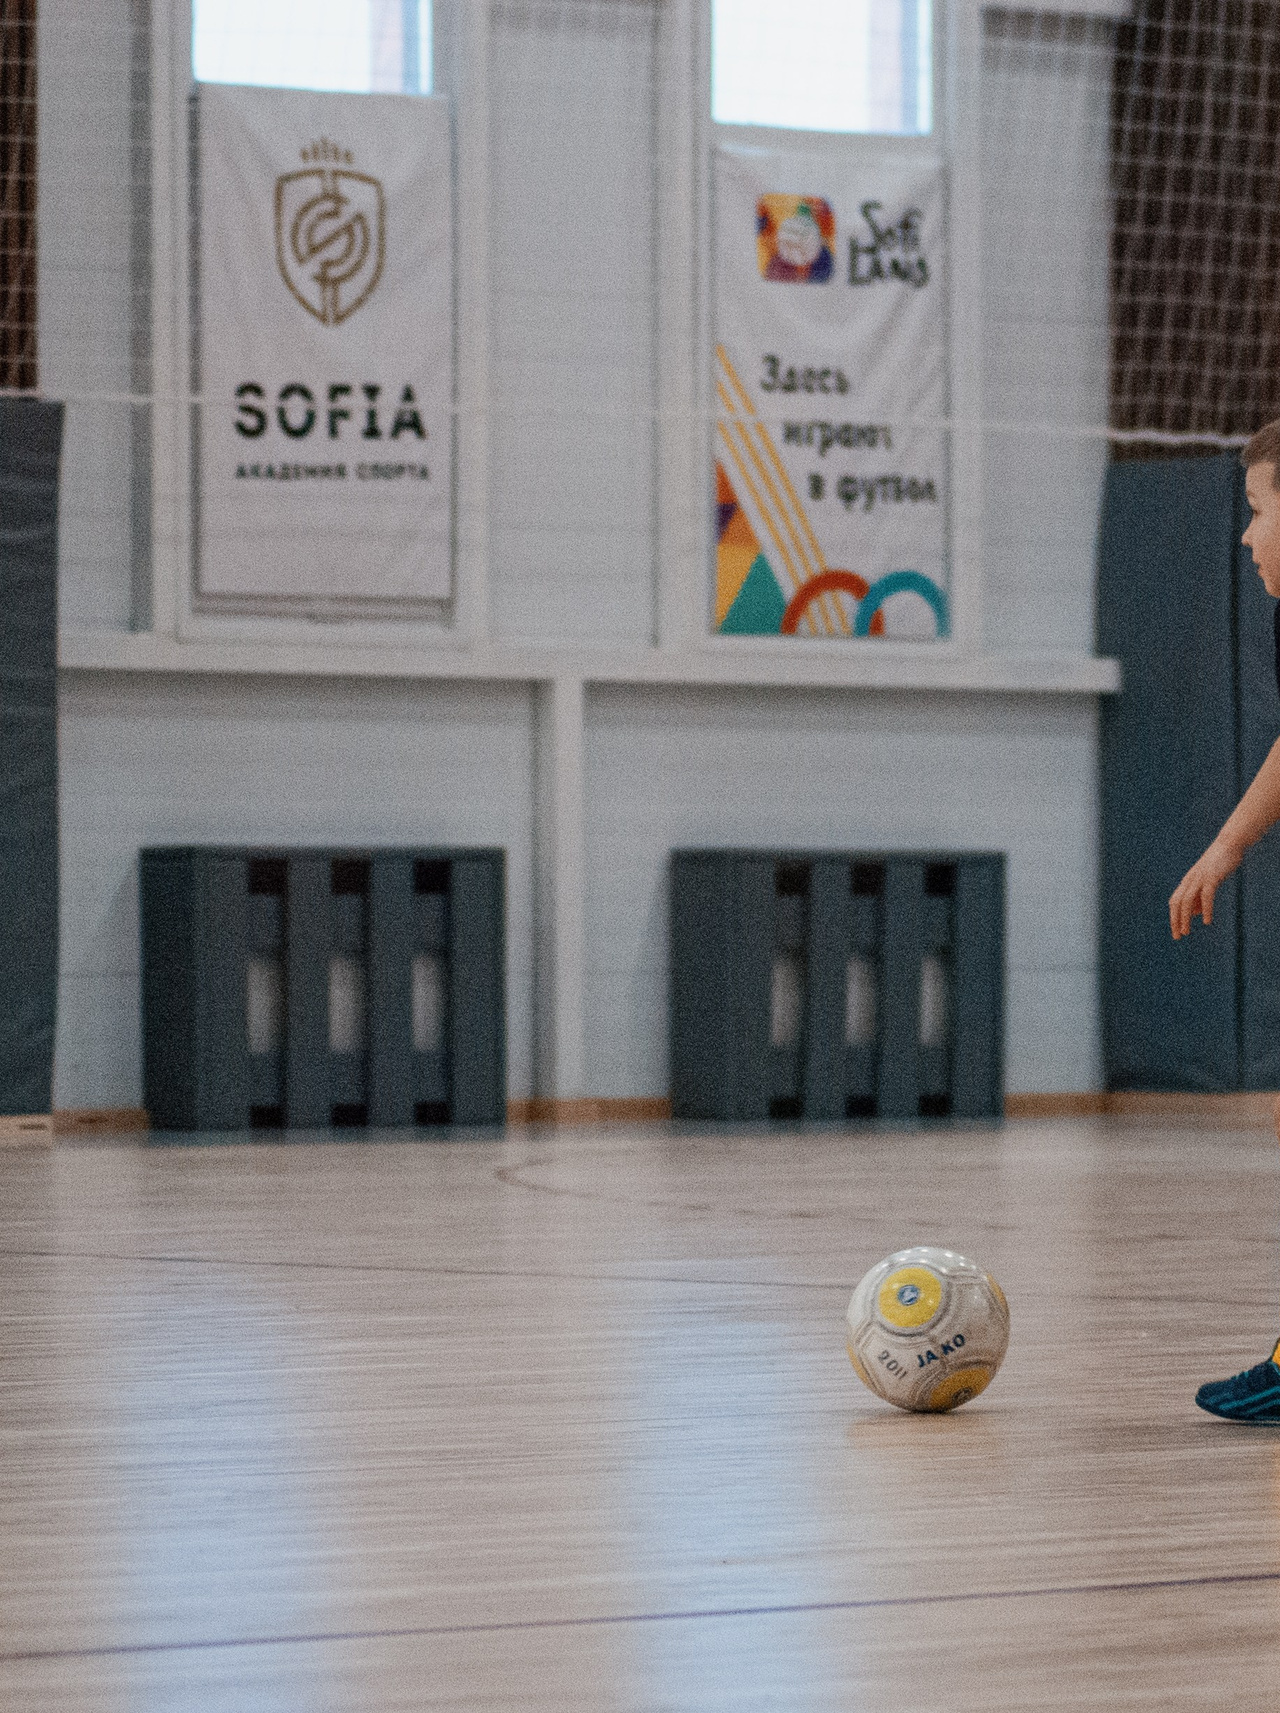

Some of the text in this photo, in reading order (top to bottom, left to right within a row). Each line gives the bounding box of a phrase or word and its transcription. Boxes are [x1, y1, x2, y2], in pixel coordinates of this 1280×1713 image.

[761, 354, 850, 396] Здесь
[234, 381, 426, 440] SOFIA
[916, 1333, 967, 1369] JAKO
